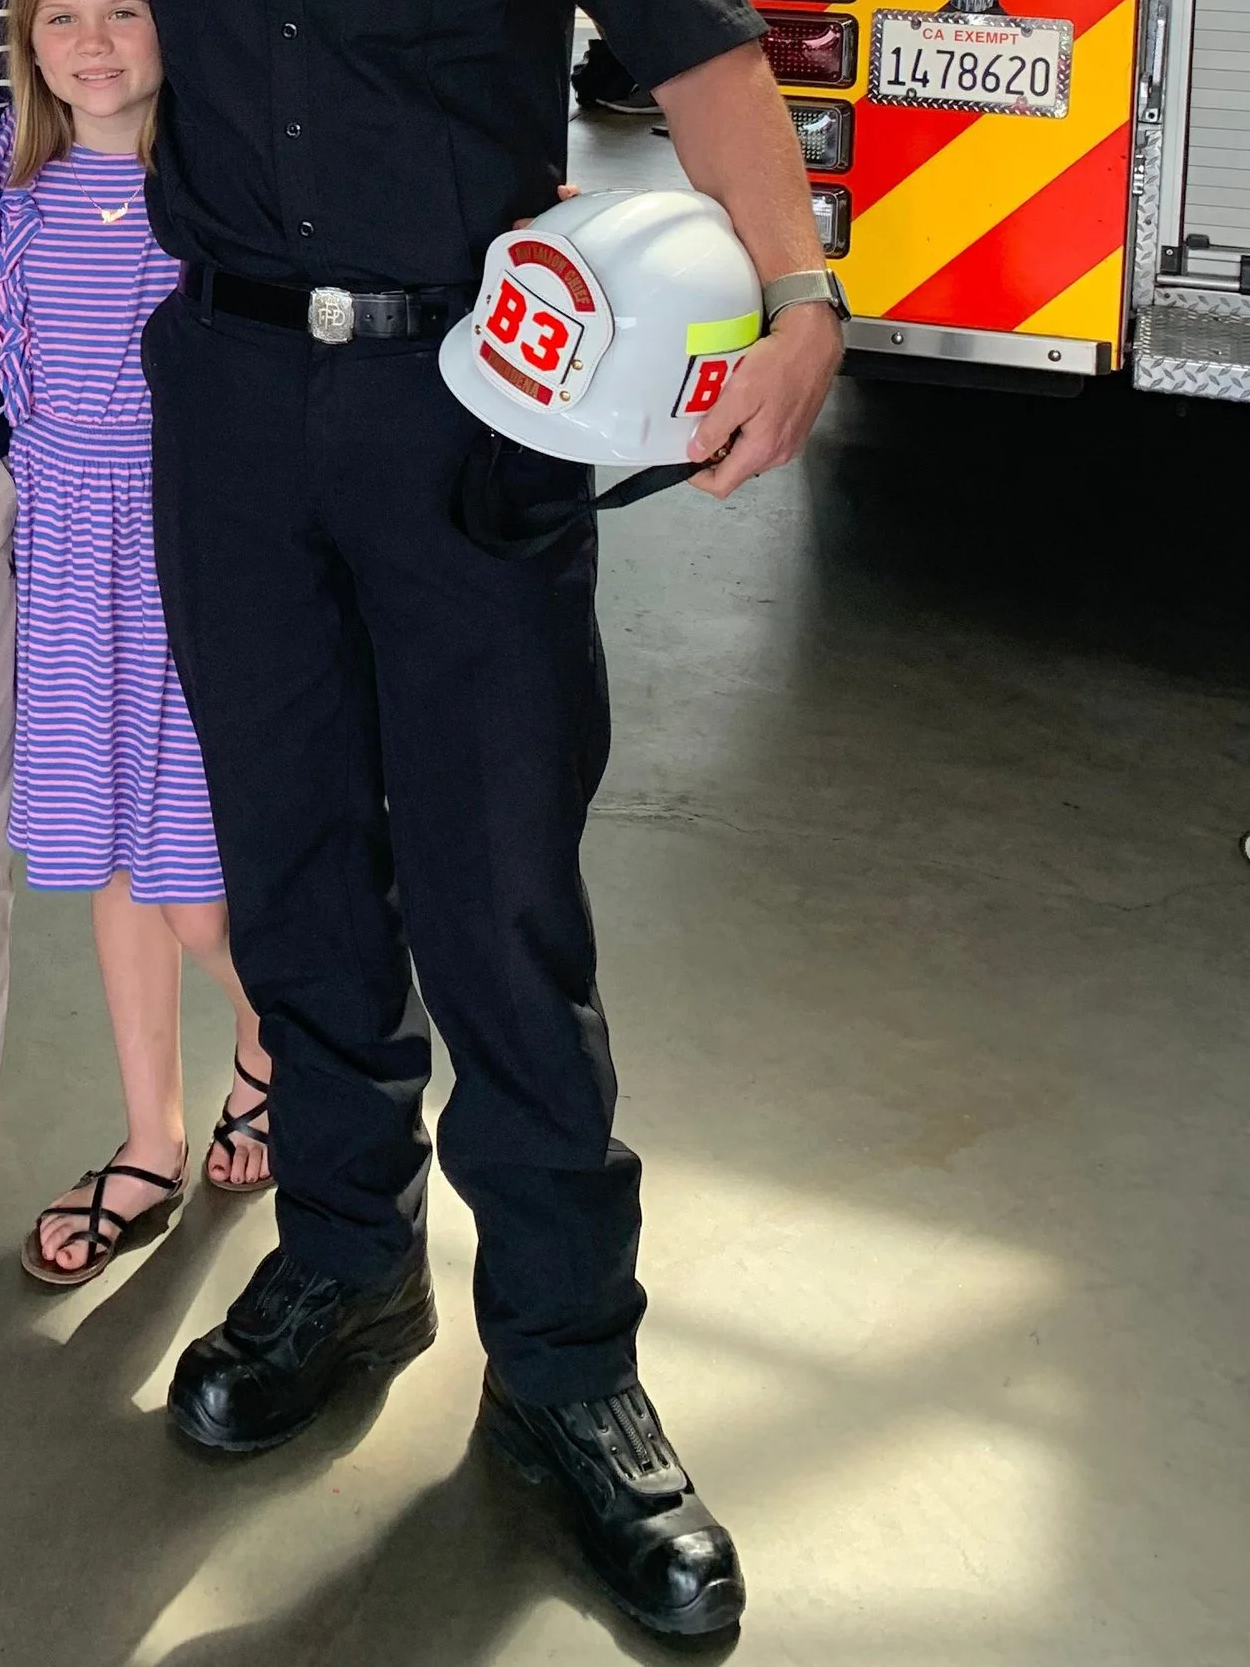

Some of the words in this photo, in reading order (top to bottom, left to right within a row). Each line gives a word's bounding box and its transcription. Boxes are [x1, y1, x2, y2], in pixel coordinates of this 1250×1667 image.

[922, 28, 944, 40] CA
[954, 30, 1019, 45] EXEMPT
[887, 46, 1051, 97] 1478620
[564, 270, 591, 304] CHIEF
[485, 278, 569, 372] B3
